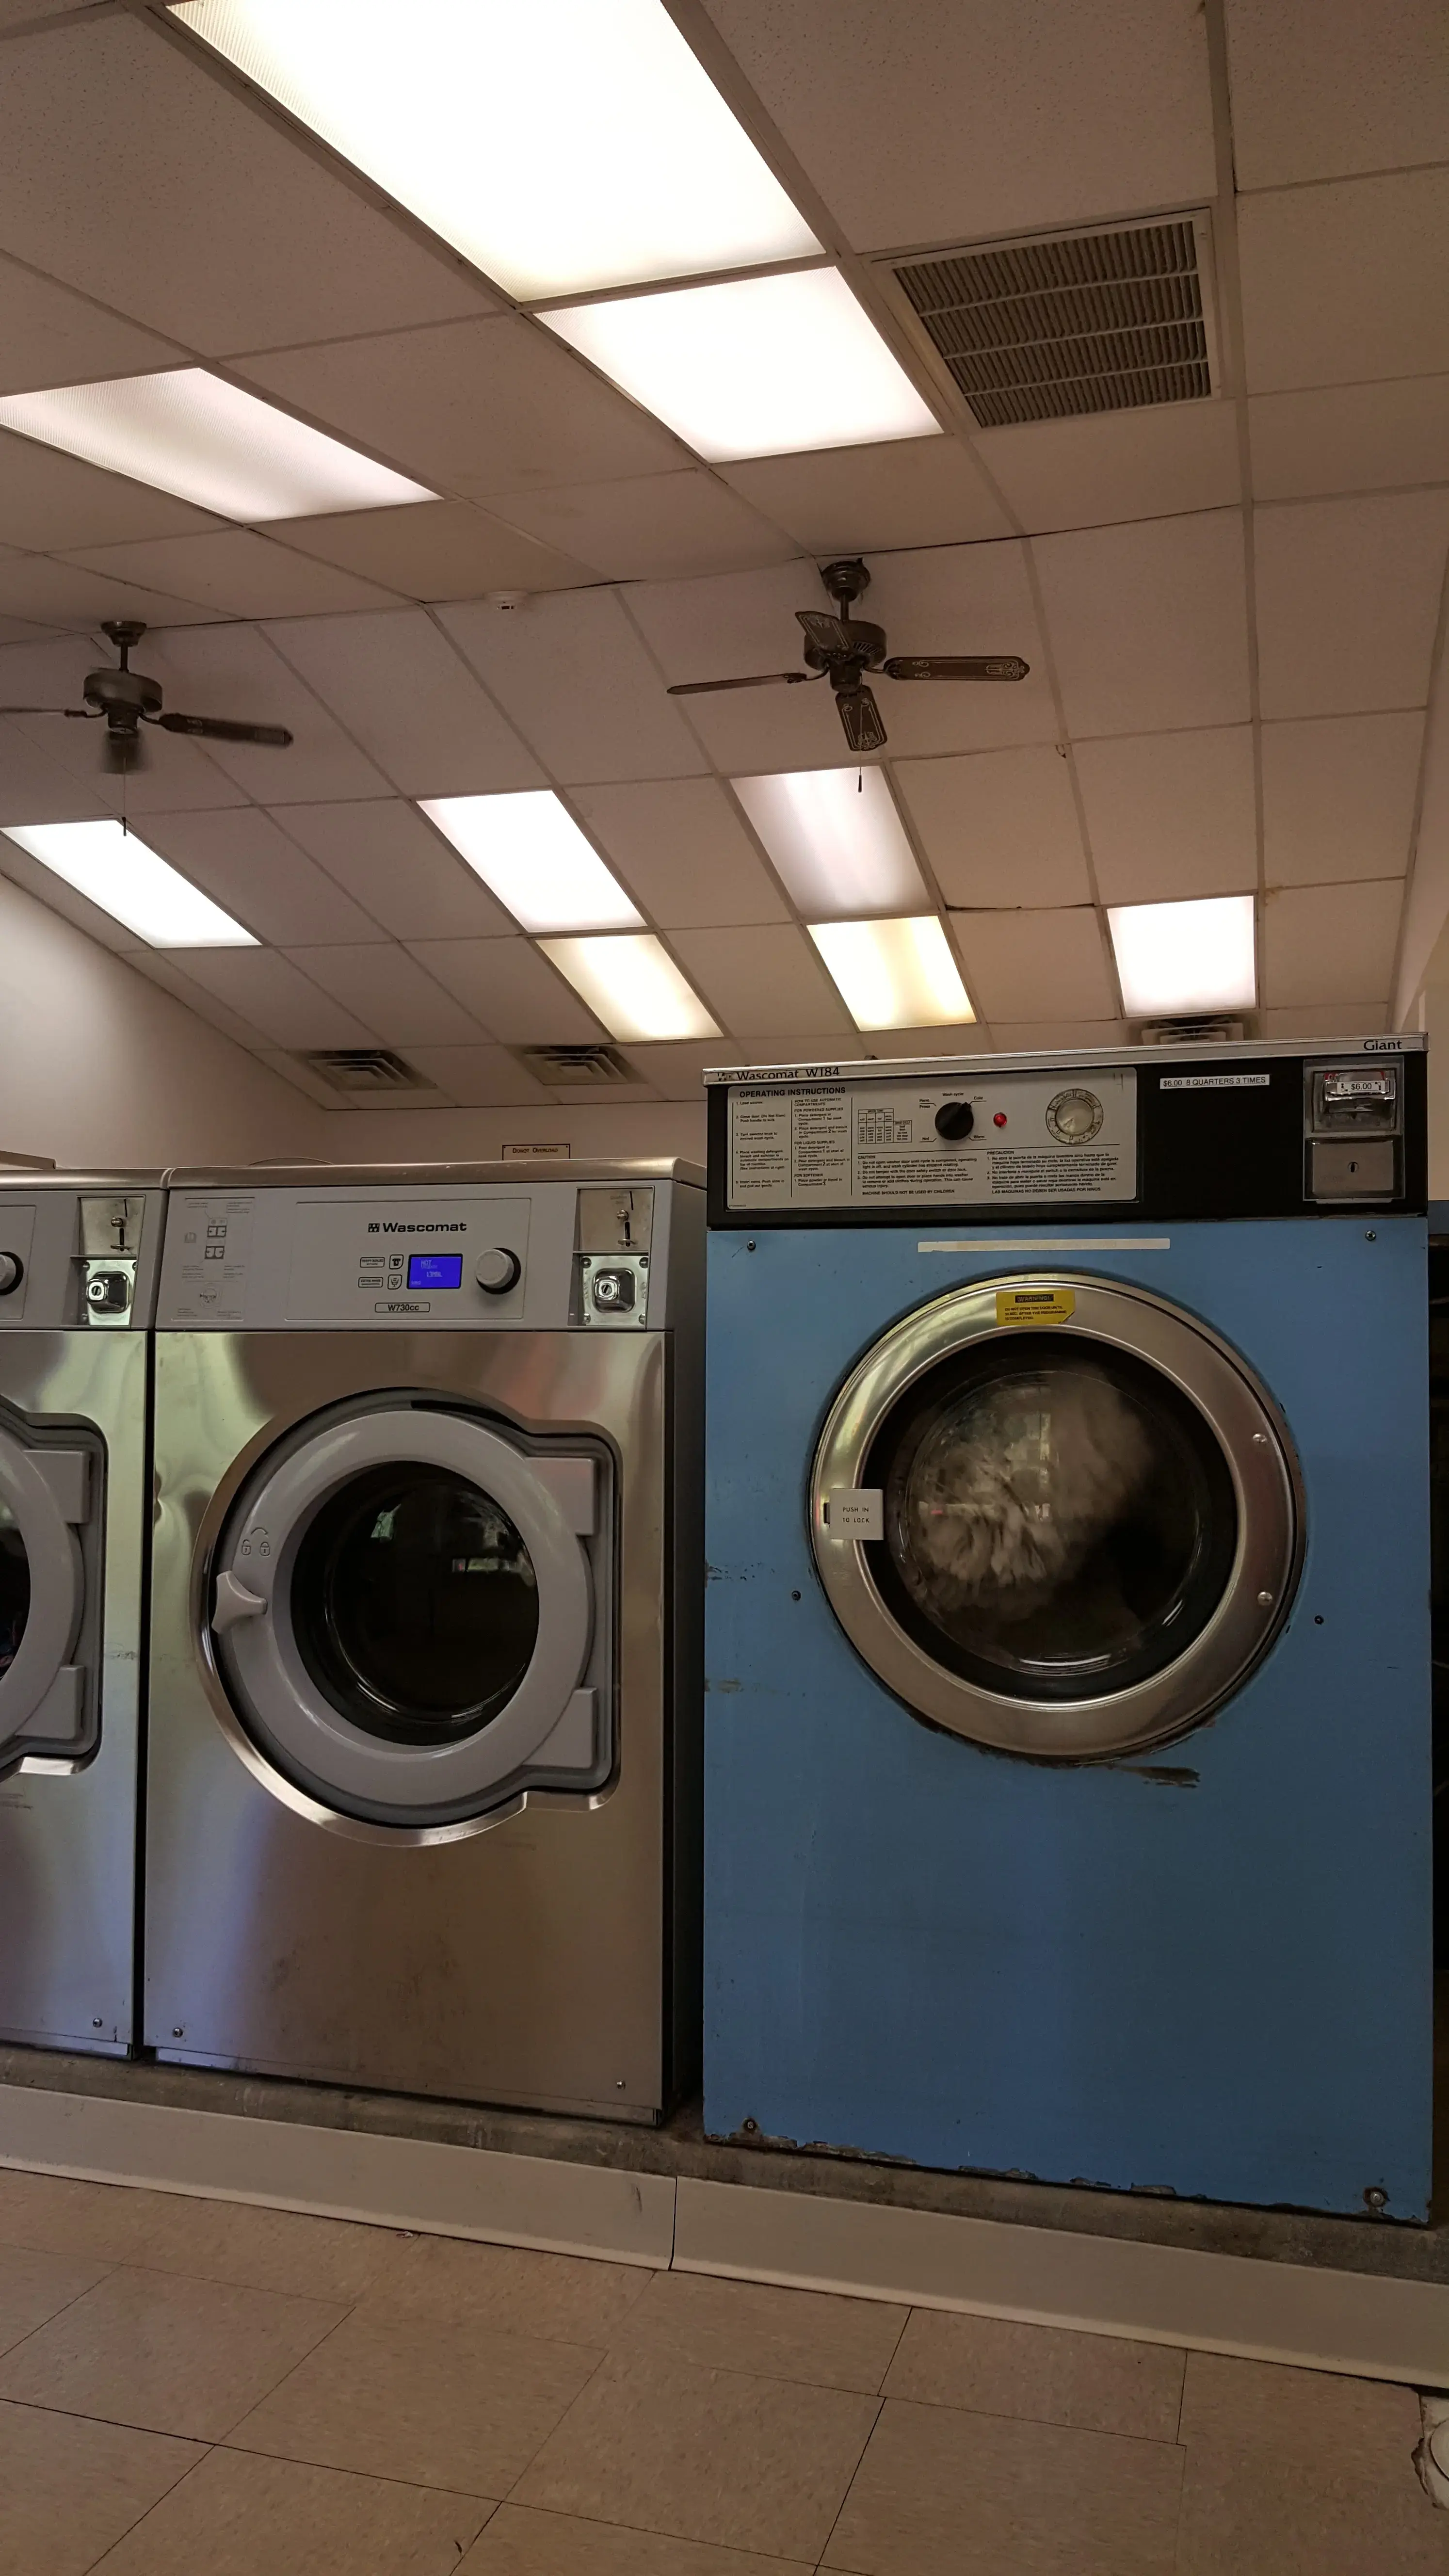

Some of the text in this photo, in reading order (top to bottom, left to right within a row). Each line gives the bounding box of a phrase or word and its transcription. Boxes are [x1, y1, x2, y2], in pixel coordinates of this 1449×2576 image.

[1364, 1040, 1402, 1050] Giant
[737, 1067, 840, 1080] Wascomat W184
[788, 1087, 846, 1095] INSTRUCTIONS
[383, 1223, 467, 1232] Wascomat
